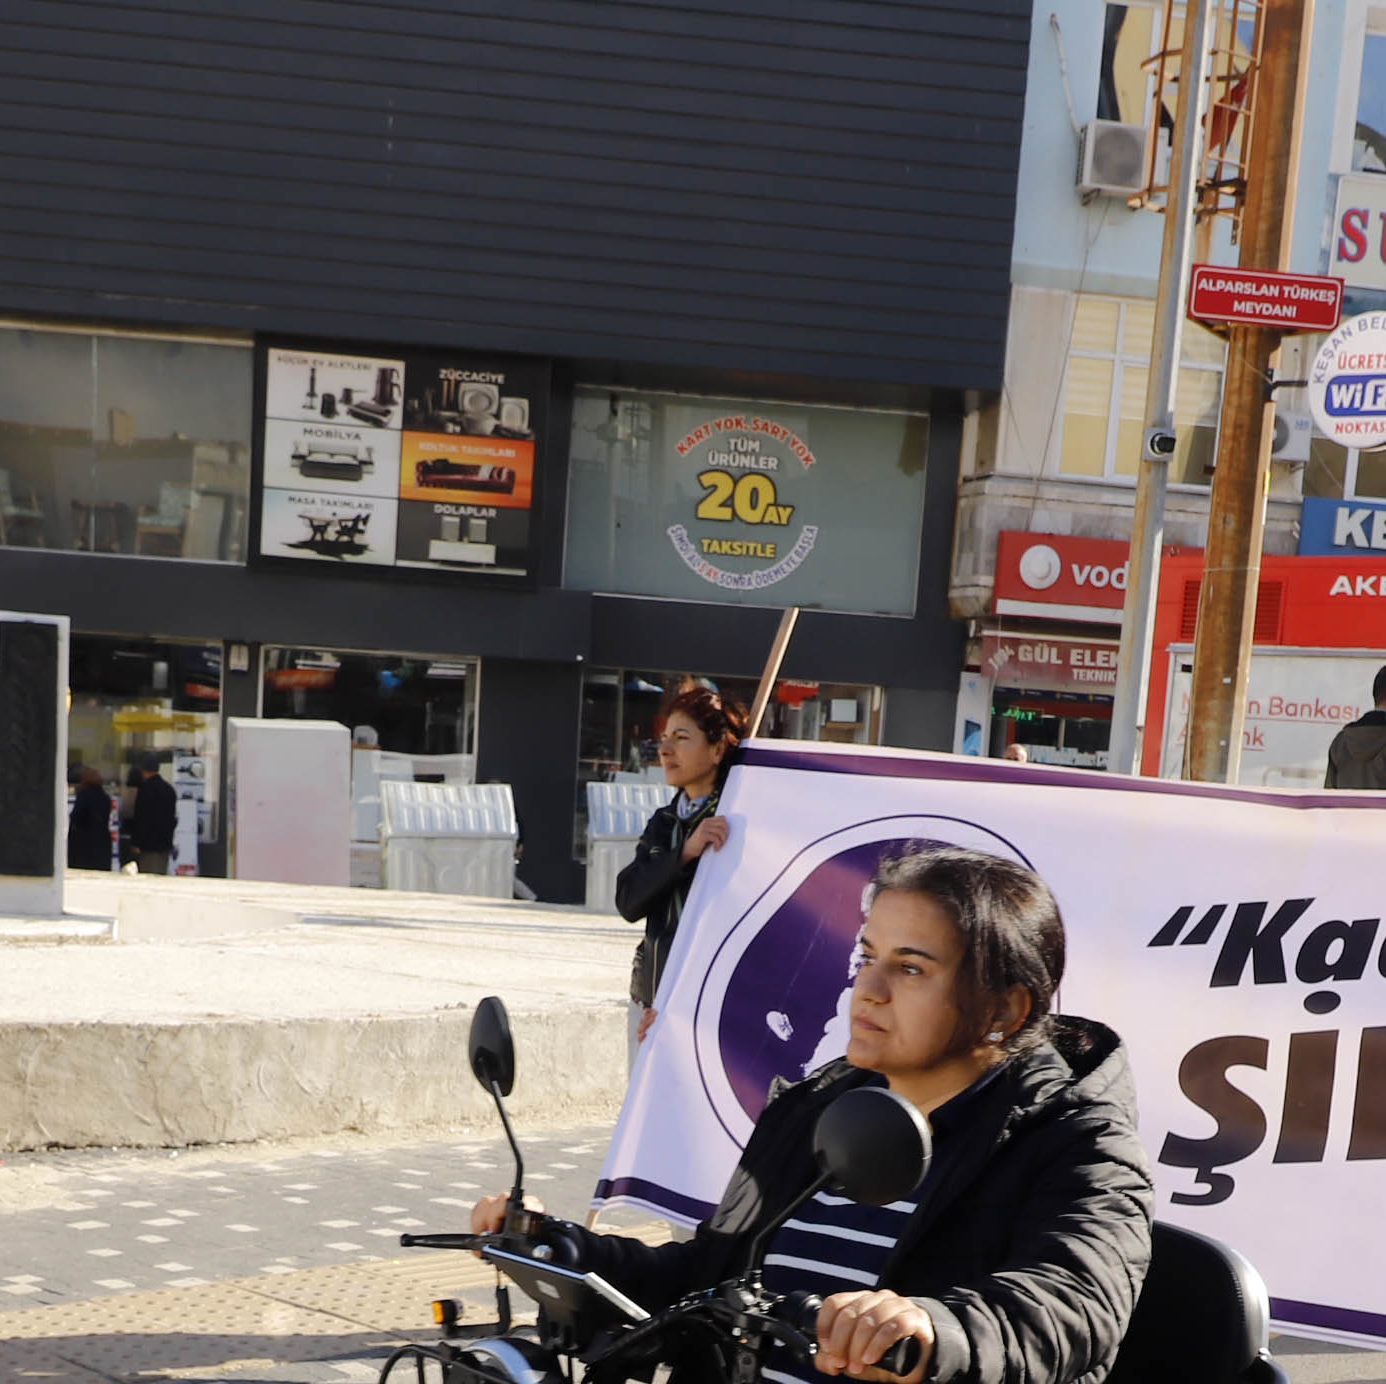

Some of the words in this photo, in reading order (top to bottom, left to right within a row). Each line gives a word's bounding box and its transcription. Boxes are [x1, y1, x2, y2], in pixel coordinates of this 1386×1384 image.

[1198, 278, 1279, 297] ALPARSLAN
[1283, 285, 1336, 305] TÜRKEŞ
[1233, 302, 1297, 318] MEYDANI
[1314, 327, 1353, 384] KEŞAN
[303, 427, 362, 441] MOBİLYA
[676, 424, 711, 456] KART
[790, 435, 815, 469] YOK
[729, 437, 760, 452] TÜM
[709, 451, 778, 470] ÜRÜNLER
[697, 470, 776, 524] 20
[763, 504, 794, 525] AY
[434, 504, 497, 519] DOLAPLAR
[1018, 643, 1062, 665] GÜL
